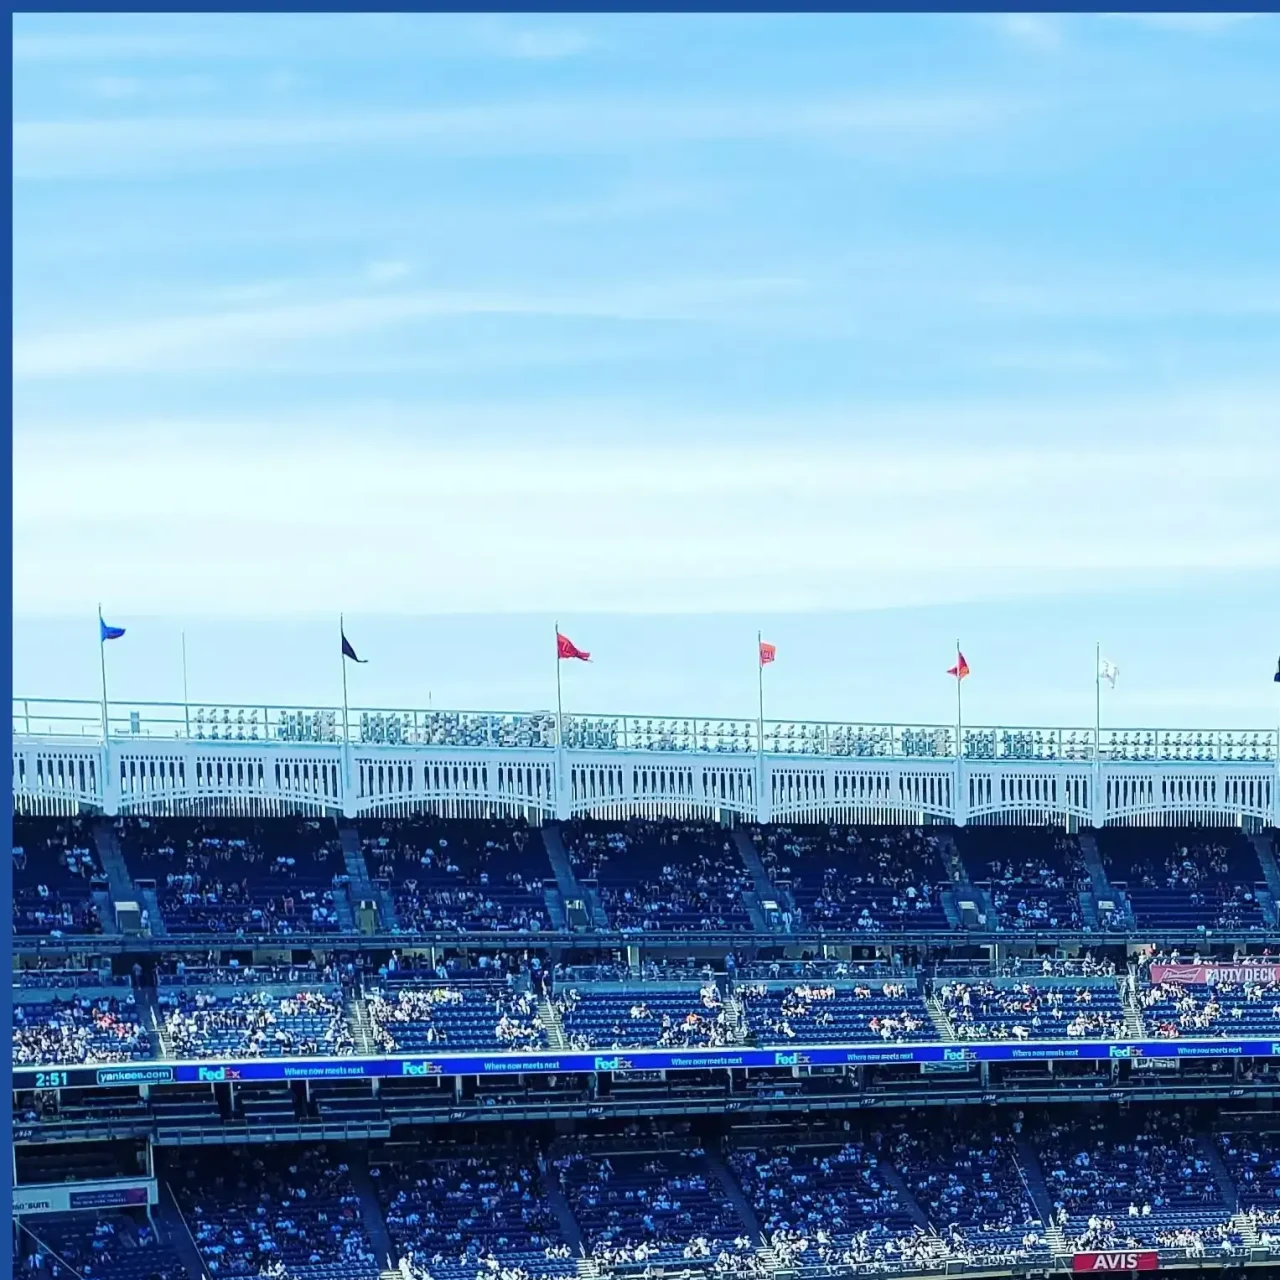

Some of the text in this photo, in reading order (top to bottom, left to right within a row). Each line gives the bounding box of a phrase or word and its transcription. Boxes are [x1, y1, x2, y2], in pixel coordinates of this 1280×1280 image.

[1244, 967, 1276, 981] DECK
[943, 1048, 977, 1061] FedEx
[1109, 1046, 1143, 1057] FedEx
[594, 1057, 632, 1070] FedEx
[775, 1052, 810, 1065] FedEx
[284, 1067, 308, 1076] Where
[325, 1066, 346, 1075] meets
[348, 1066, 364, 1074] next
[402, 1061, 442, 1075] FedEx
[484, 1061, 506, 1070] Where
[522, 1061, 543, 1070] meets
[544, 1061, 560, 1069] next
[35, 1072, 67, 1087] 2:51
[100, 1070, 169, 1083] yankees.com
[198, 1066, 241, 1081] FedEx
[28, 1201, 49, 1209] SUITE
[1093, 1254, 1138, 1270] AVIS
